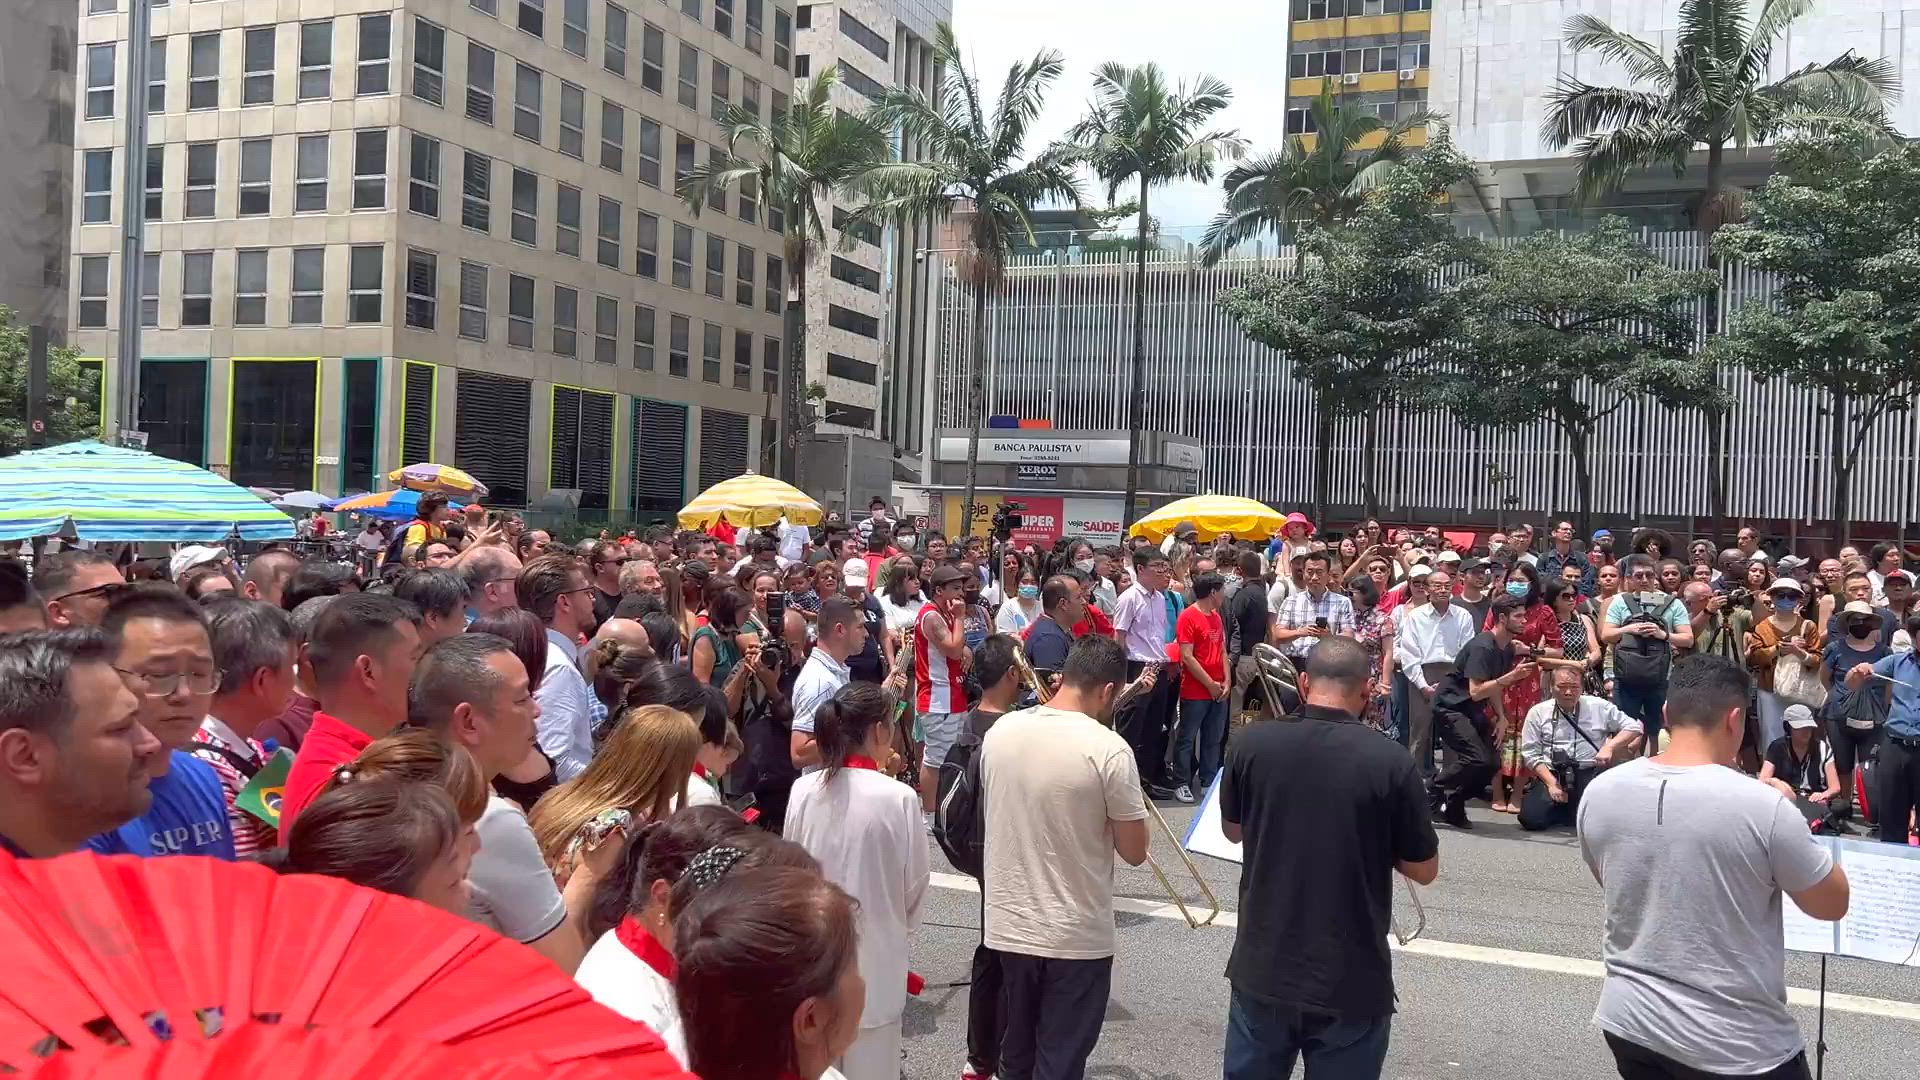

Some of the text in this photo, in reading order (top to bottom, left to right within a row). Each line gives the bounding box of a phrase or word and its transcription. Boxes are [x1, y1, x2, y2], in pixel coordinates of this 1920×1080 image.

[994, 443, 1082, 453] BANCA PAULISTA V
[1019, 465, 1057, 475] XEROX
[961, 502, 989, 517] eja
[1021, 514, 1055, 527] UPER
[1068, 520, 1120, 533] veja SAÚDE
[150, 819, 224, 856] SUPER
